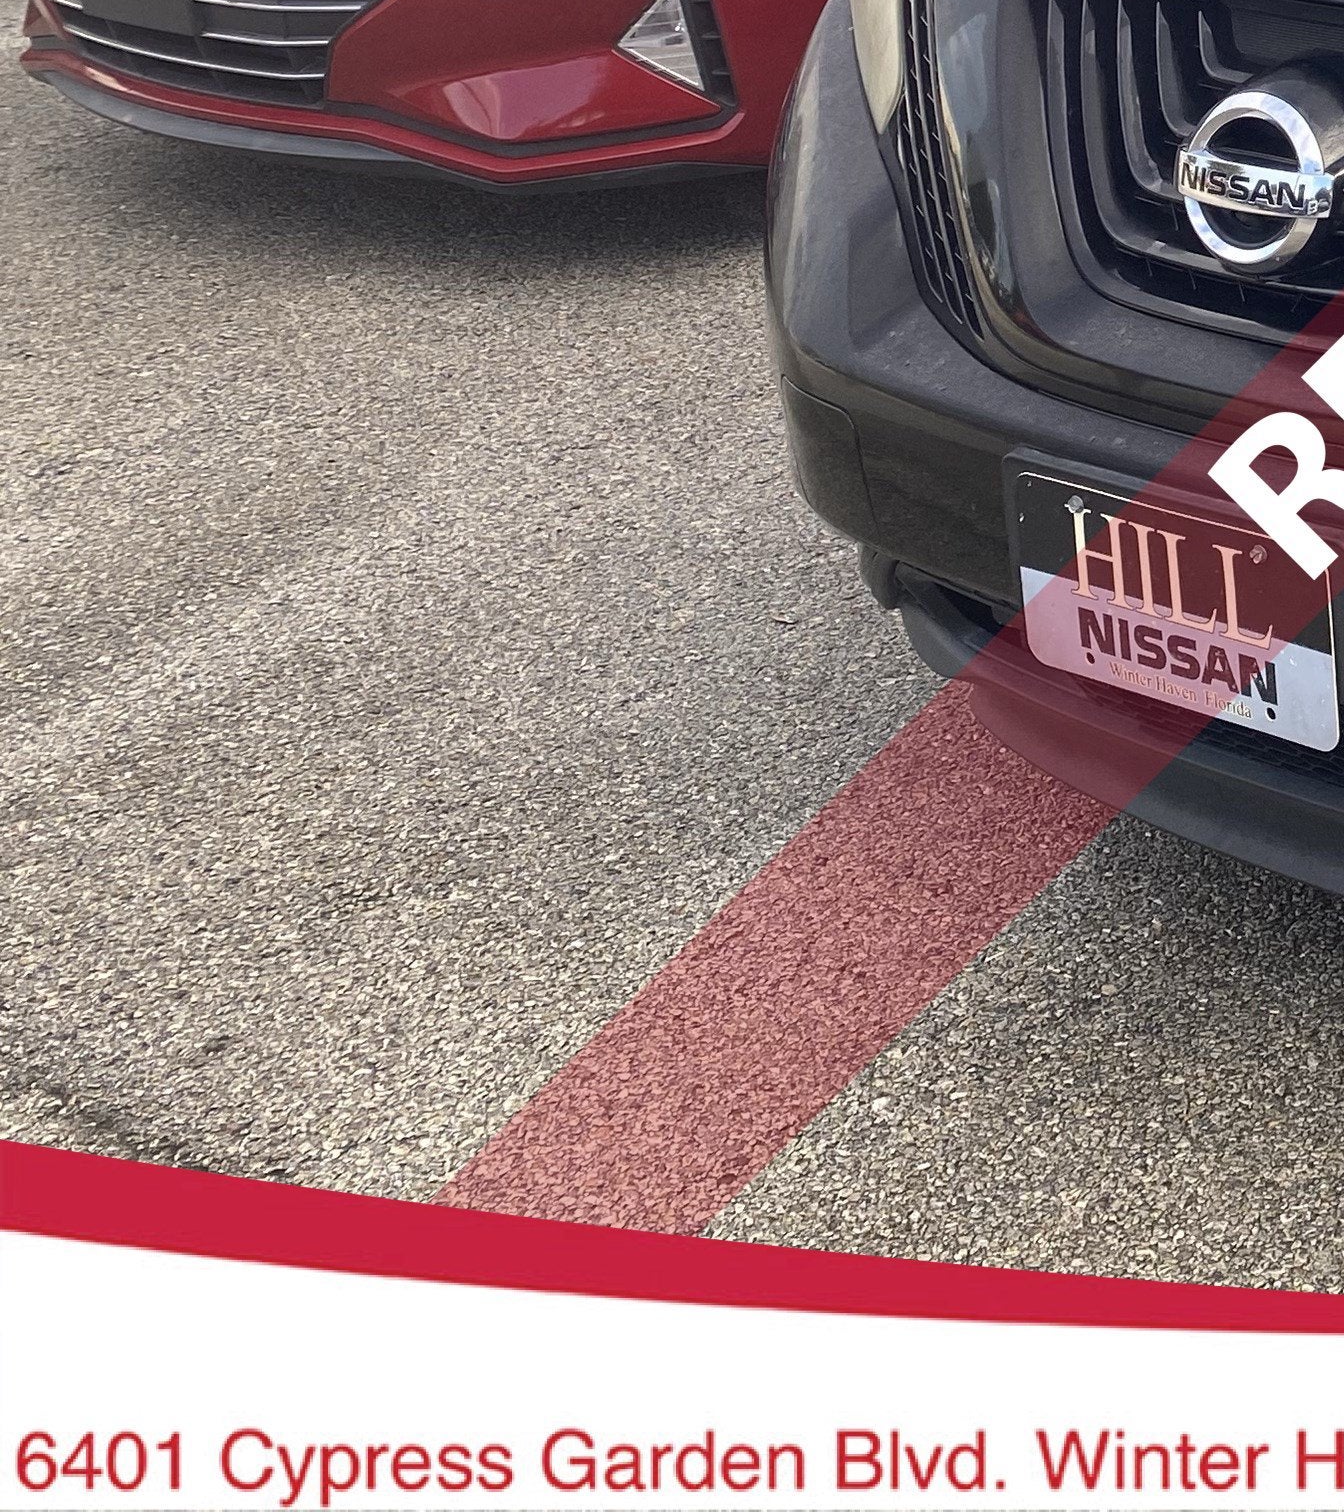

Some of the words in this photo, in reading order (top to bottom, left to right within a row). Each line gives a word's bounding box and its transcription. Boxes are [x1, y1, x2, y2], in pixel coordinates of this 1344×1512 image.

[1181, 163, 1306, 208] NISSAN
[1064, 503, 1273, 650] HILL
[1078, 607, 1278, 705] NISSAN
[1108, 661, 1152, 687] Winter
[1156, 676, 1197, 702] Haven
[1205, 691, 1252, 718] Florida
